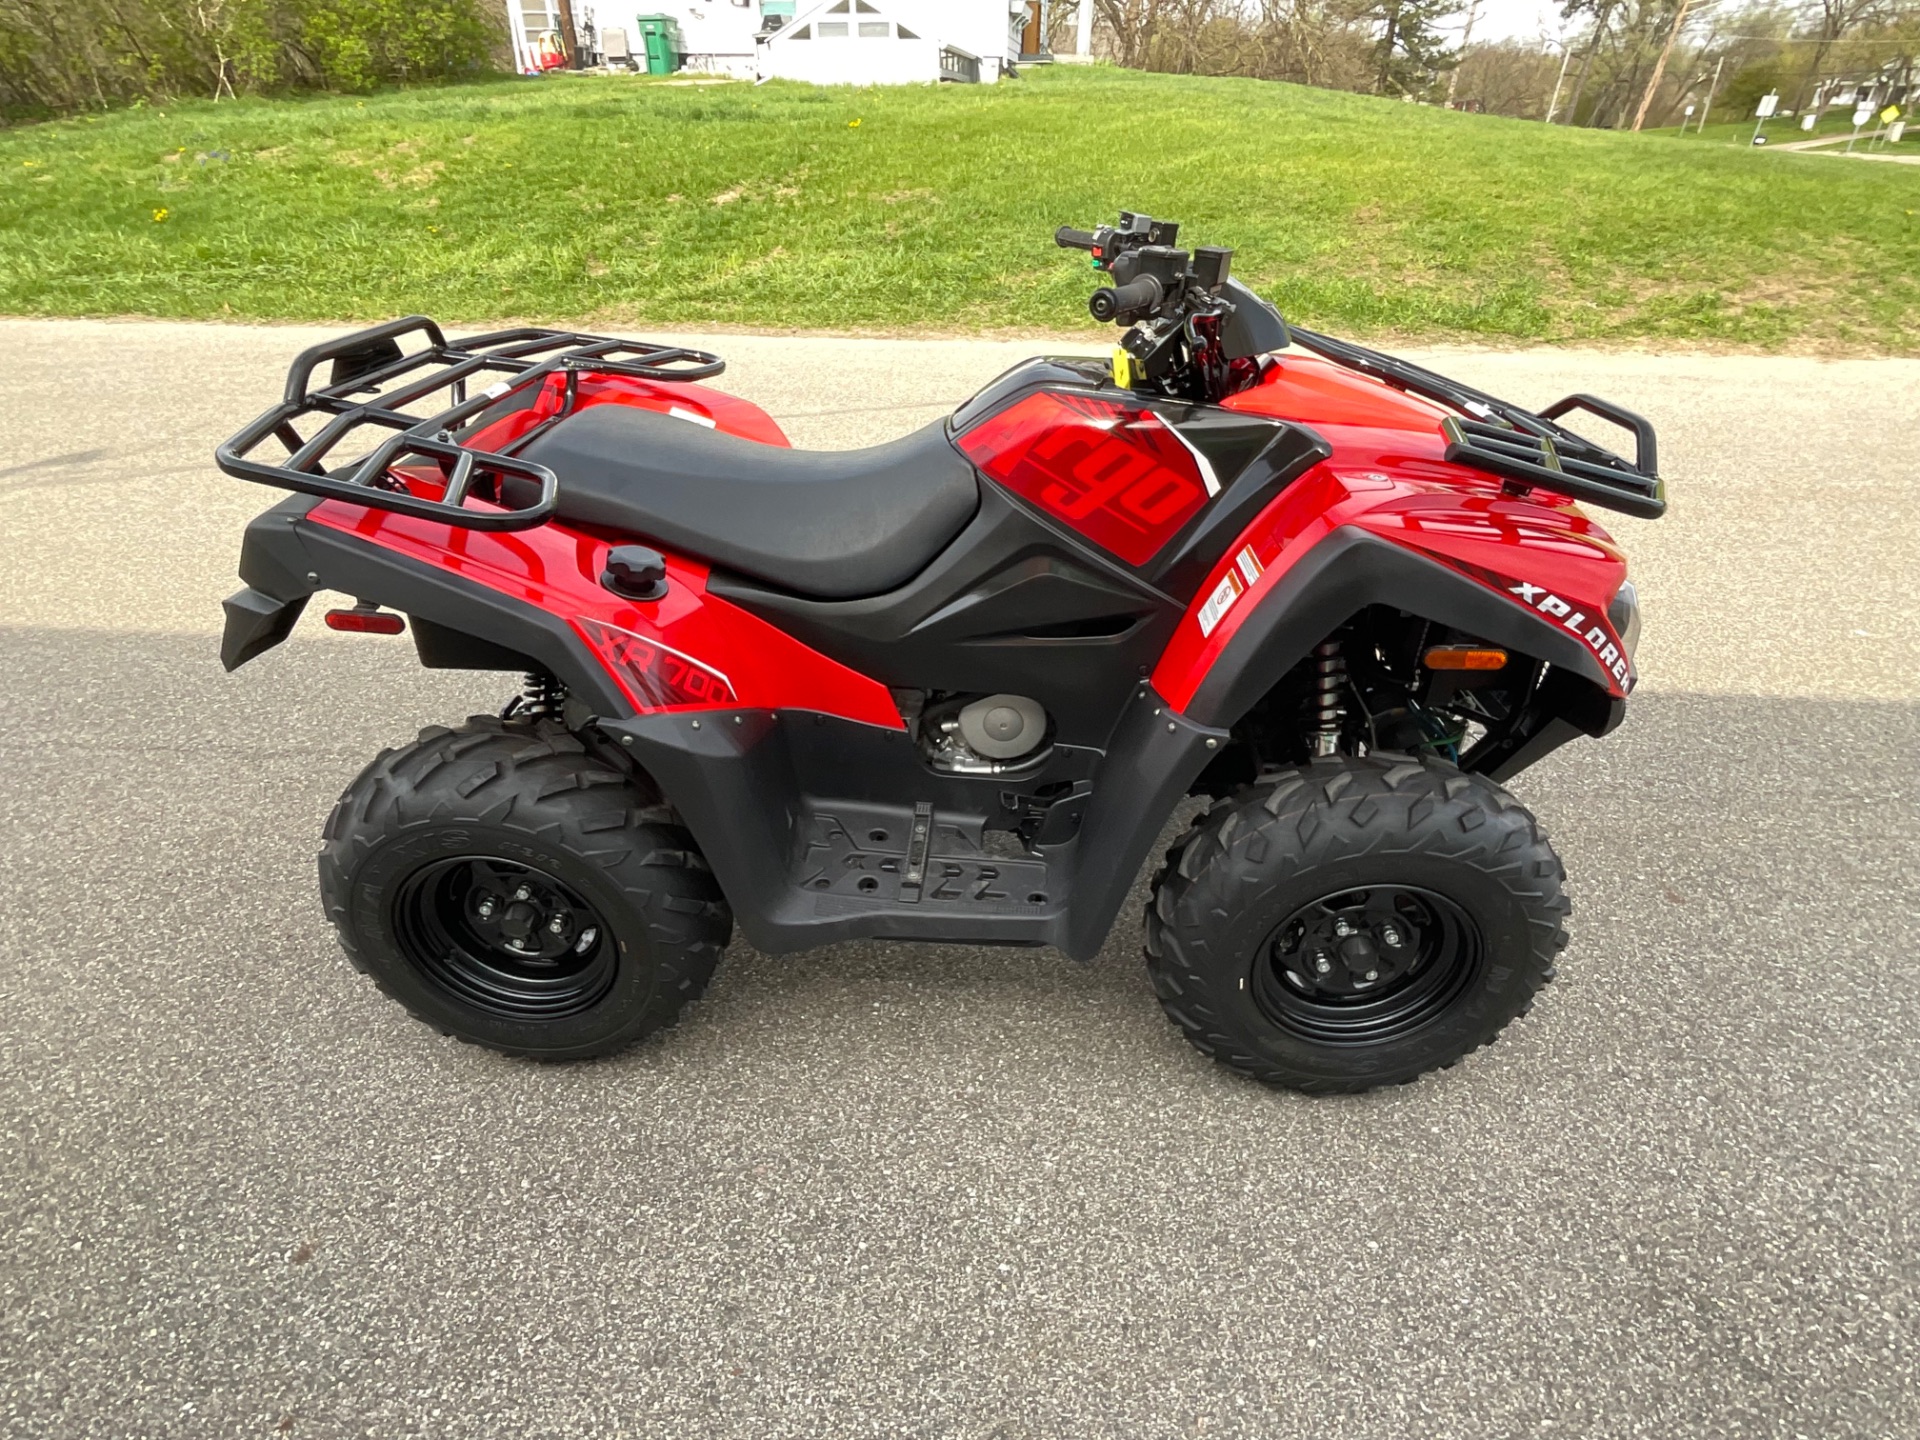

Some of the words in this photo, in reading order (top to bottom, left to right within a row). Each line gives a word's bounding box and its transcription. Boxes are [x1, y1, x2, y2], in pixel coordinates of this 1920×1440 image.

[598, 627, 656, 674] XR
[663, 655, 730, 704] 700
[1508, 581, 1630, 695] XPLORER
